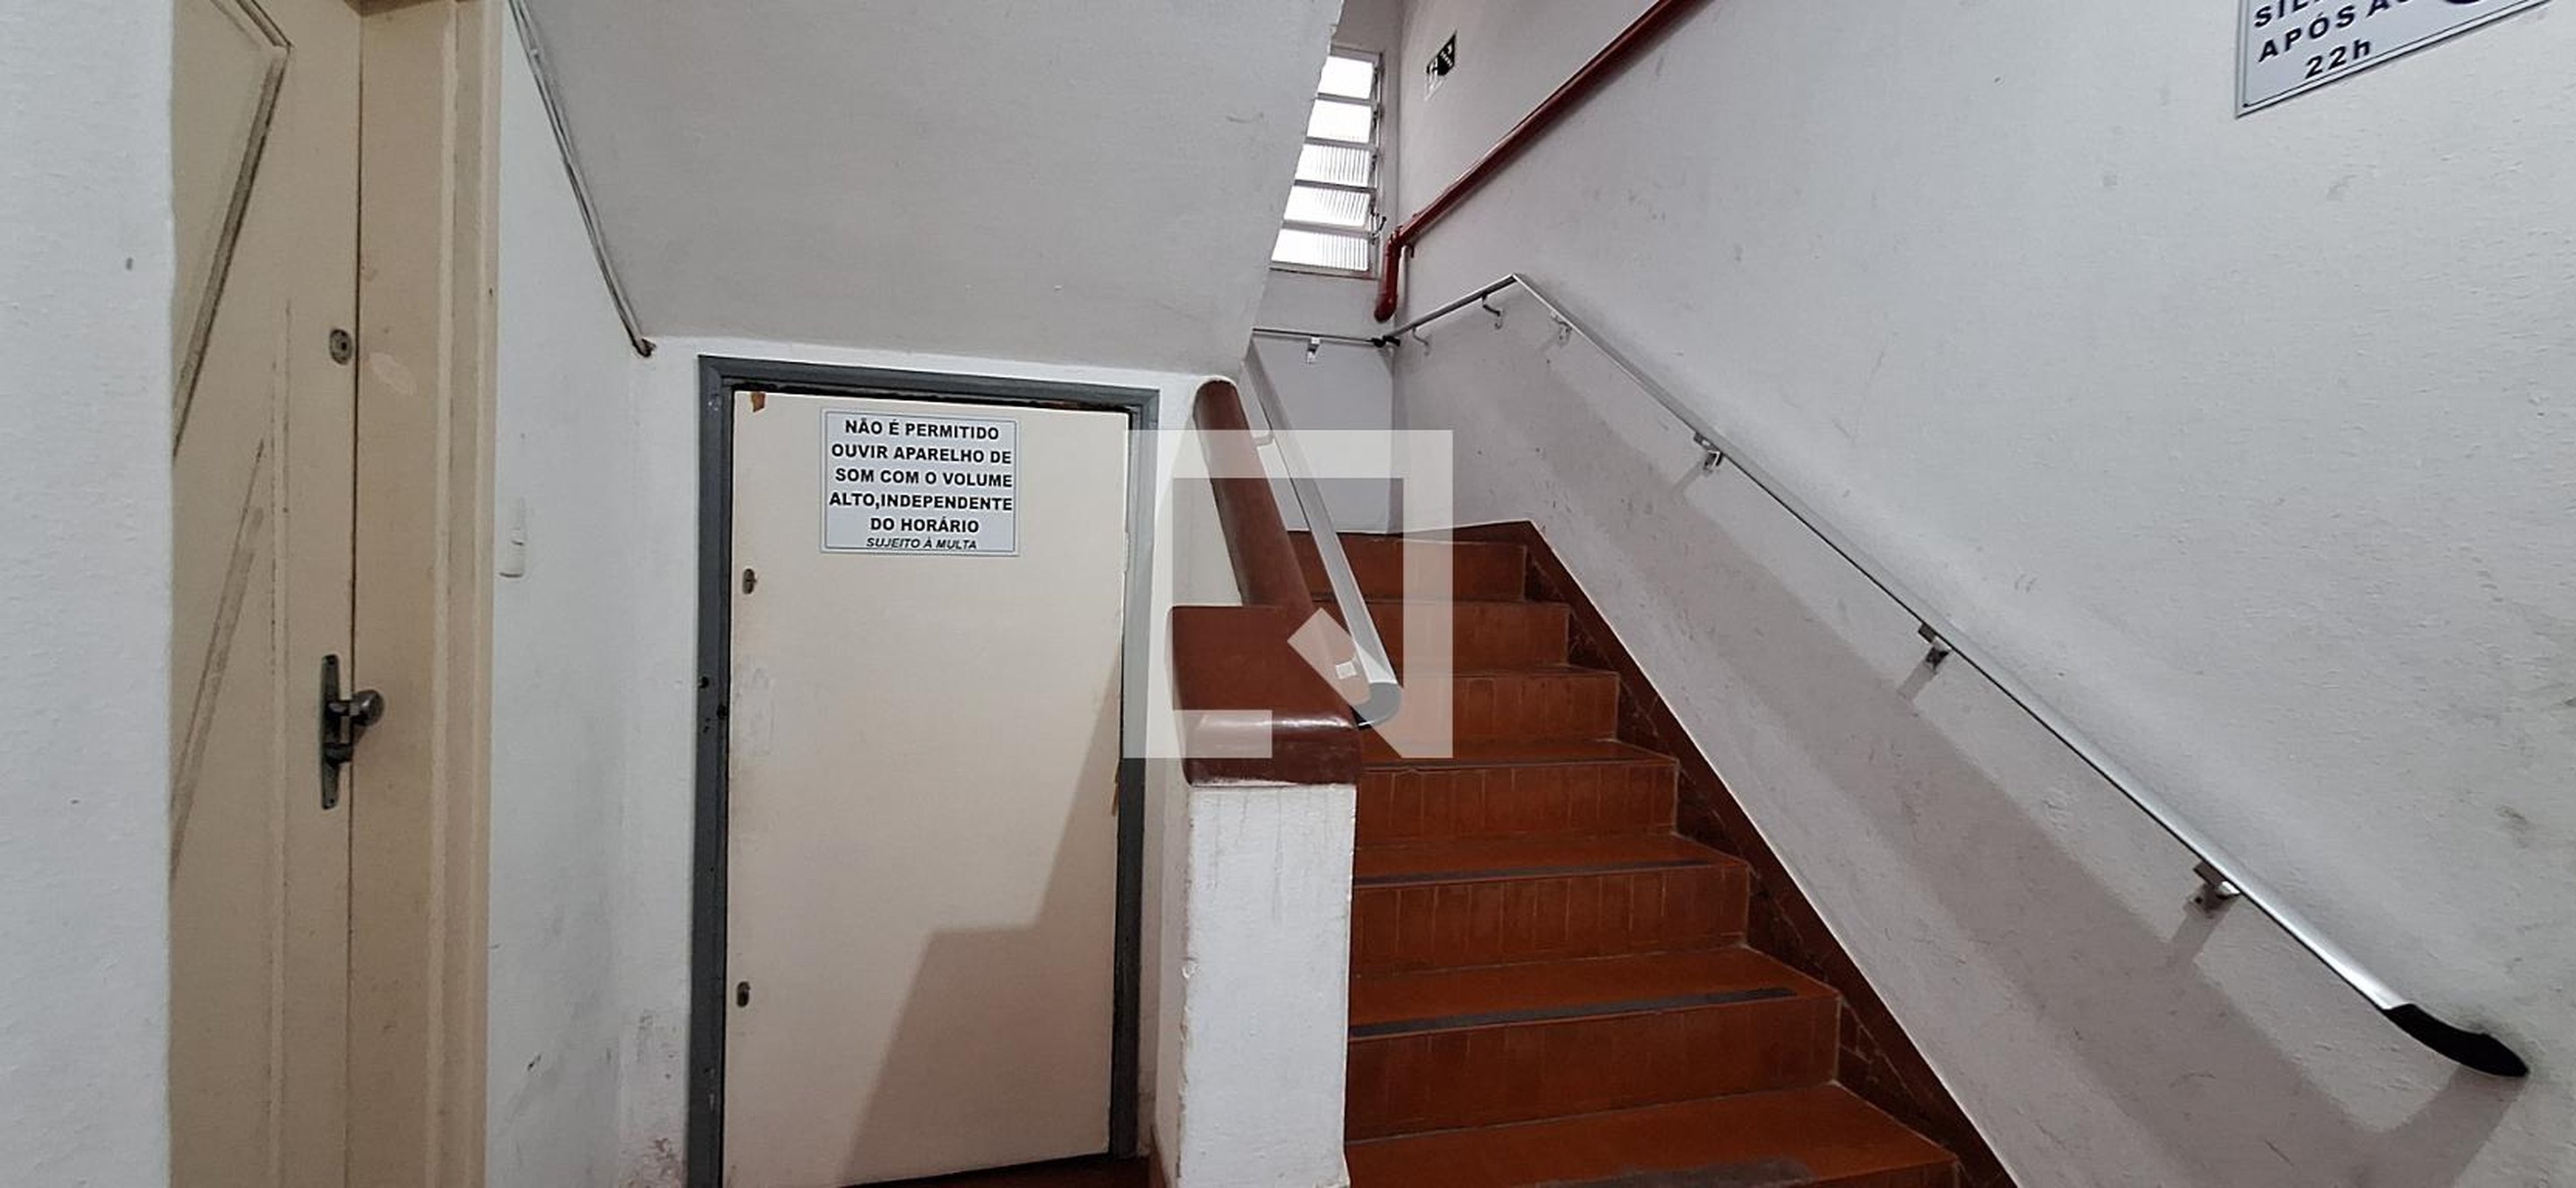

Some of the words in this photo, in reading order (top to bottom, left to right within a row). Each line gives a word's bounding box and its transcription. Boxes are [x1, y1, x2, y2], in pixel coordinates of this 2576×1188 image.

[2254, 0, 2320, 28] SIL
[2258, 5, 2355, 62] APÓS
[2304, 39, 2370, 79] 22h
[845, 418, 883, 435] NÃO
[889, 419, 900, 435] É
[905, 423, 999, 440] PERMITIDO
[831, 443, 888, 459] OUVIR
[894, 446, 984, 463] APARELHO
[990, 450, 1012, 464] DE
[835, 468, 874, 483] SOM
[880, 470, 919, 484] COM
[925, 472, 937, 485] O
[943, 472, 1012, 488] VOLUME
[871, 517, 895, 531] DO
[901, 517, 979, 533] HORÁRIO
[866, 537, 920, 549] SUJEITO
[936, 539, 977, 550] MULTA
